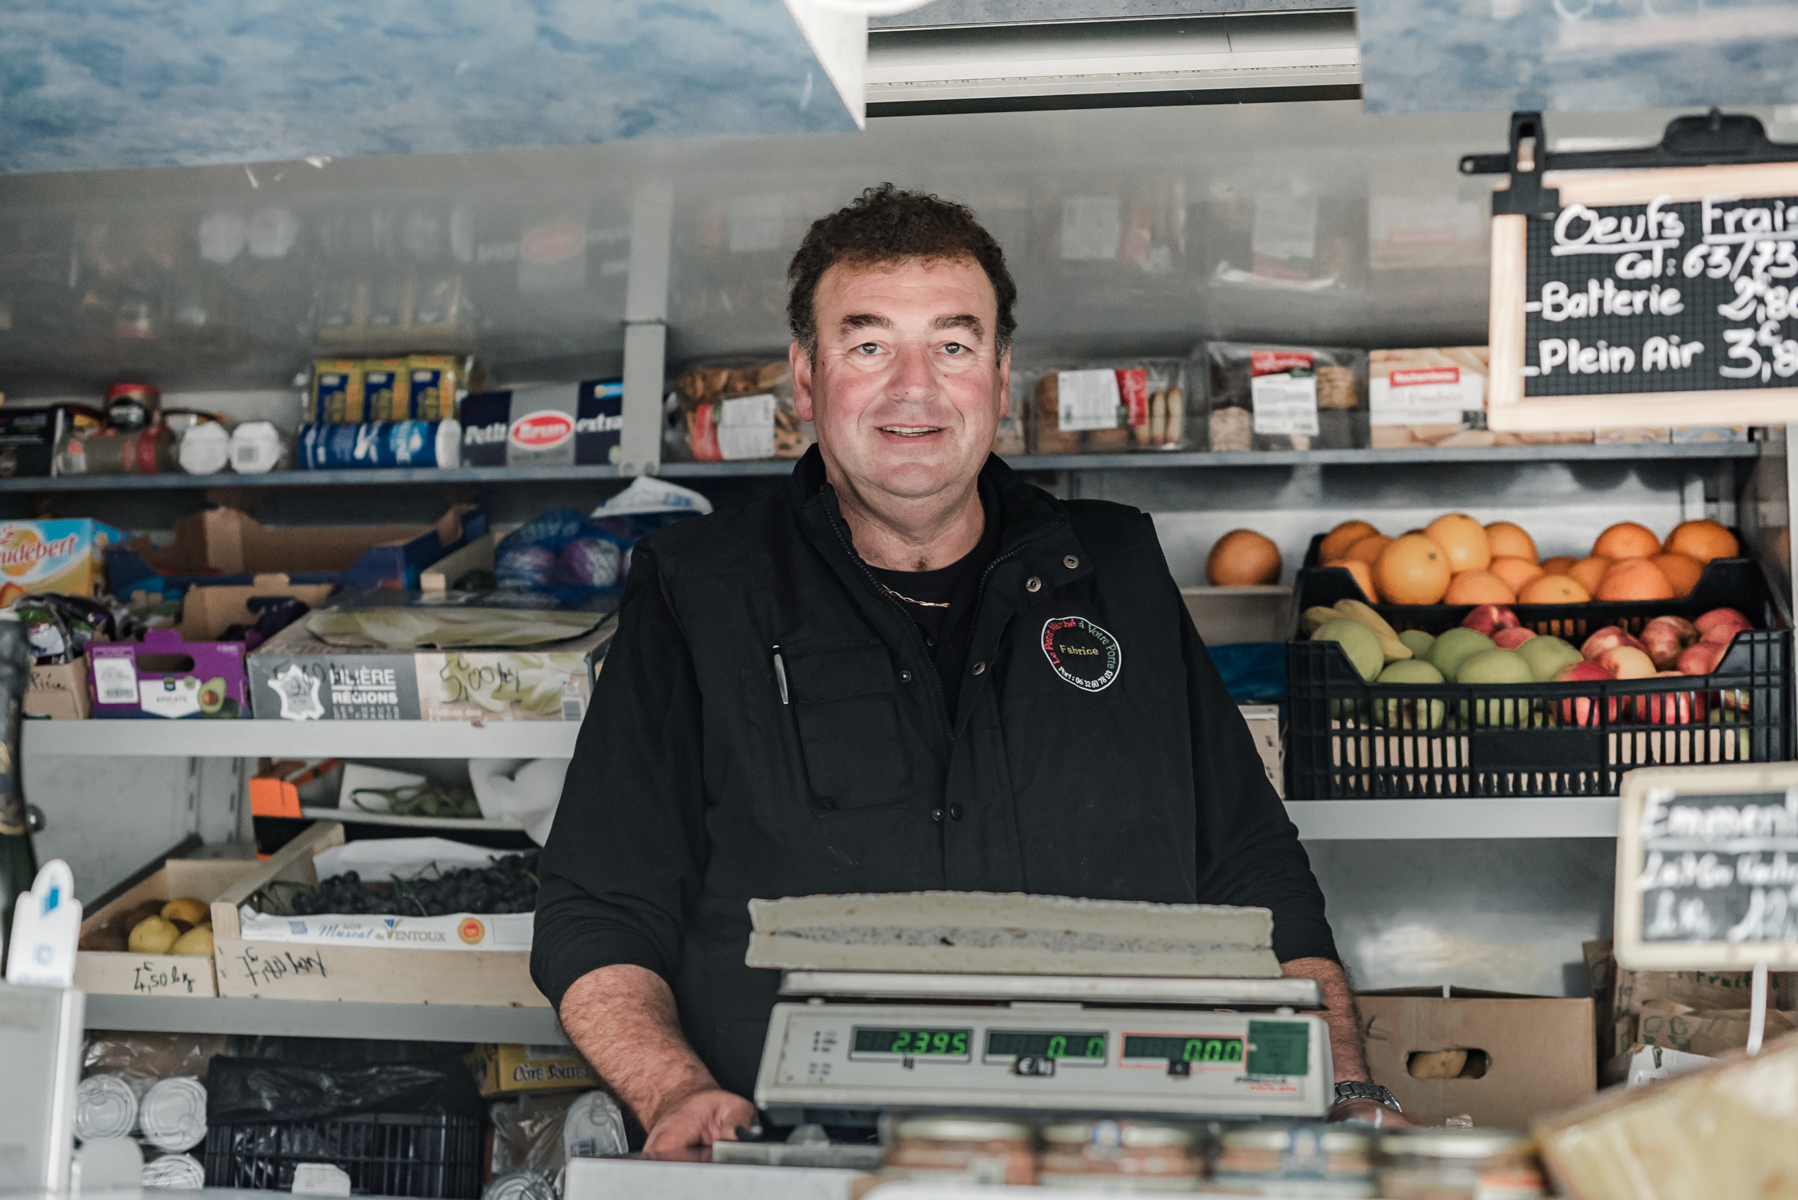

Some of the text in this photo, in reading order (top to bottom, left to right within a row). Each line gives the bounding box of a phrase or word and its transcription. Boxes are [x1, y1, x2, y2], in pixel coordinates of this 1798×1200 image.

[1554, 194, 1685, 246] Oeufs
[1643, 334, 1704, 373] Air
[0, 535, 77, 565] udebert
[1059, 644, 1099, 656] Fabrice
[1088, 624, 1110, 645] Votre
[1105, 642, 1117, 670] Porte
[318, 923, 374, 939] Muscat
[891, 1032, 967, 1056] 2.395
